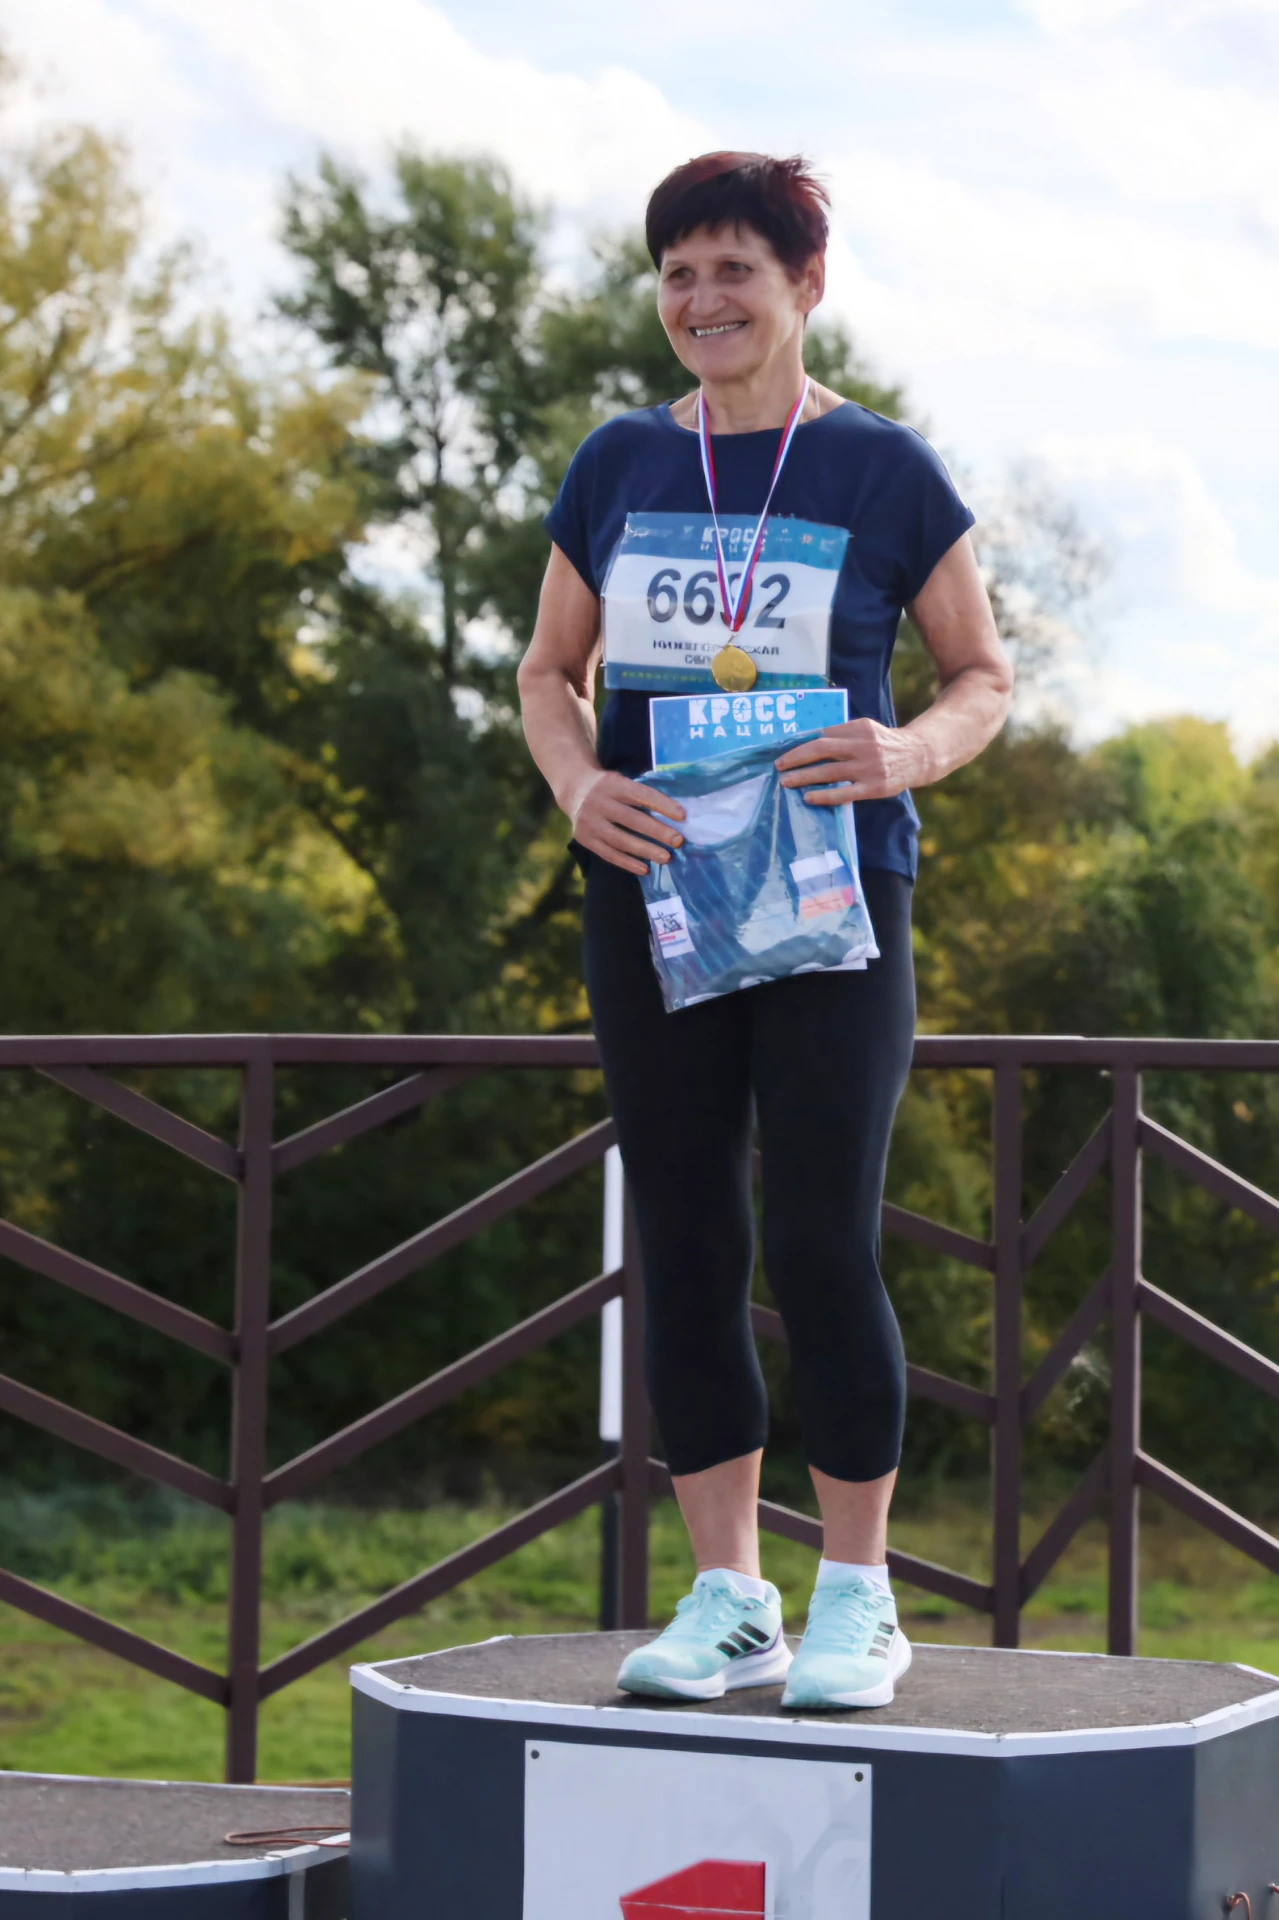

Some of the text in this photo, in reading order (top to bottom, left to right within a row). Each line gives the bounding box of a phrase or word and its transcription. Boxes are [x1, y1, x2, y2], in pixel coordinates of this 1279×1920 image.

[702, 527, 768, 544] КРОС
[688, 694, 797, 725] КРОСС
[690, 722, 798, 740] НАЦИИ
